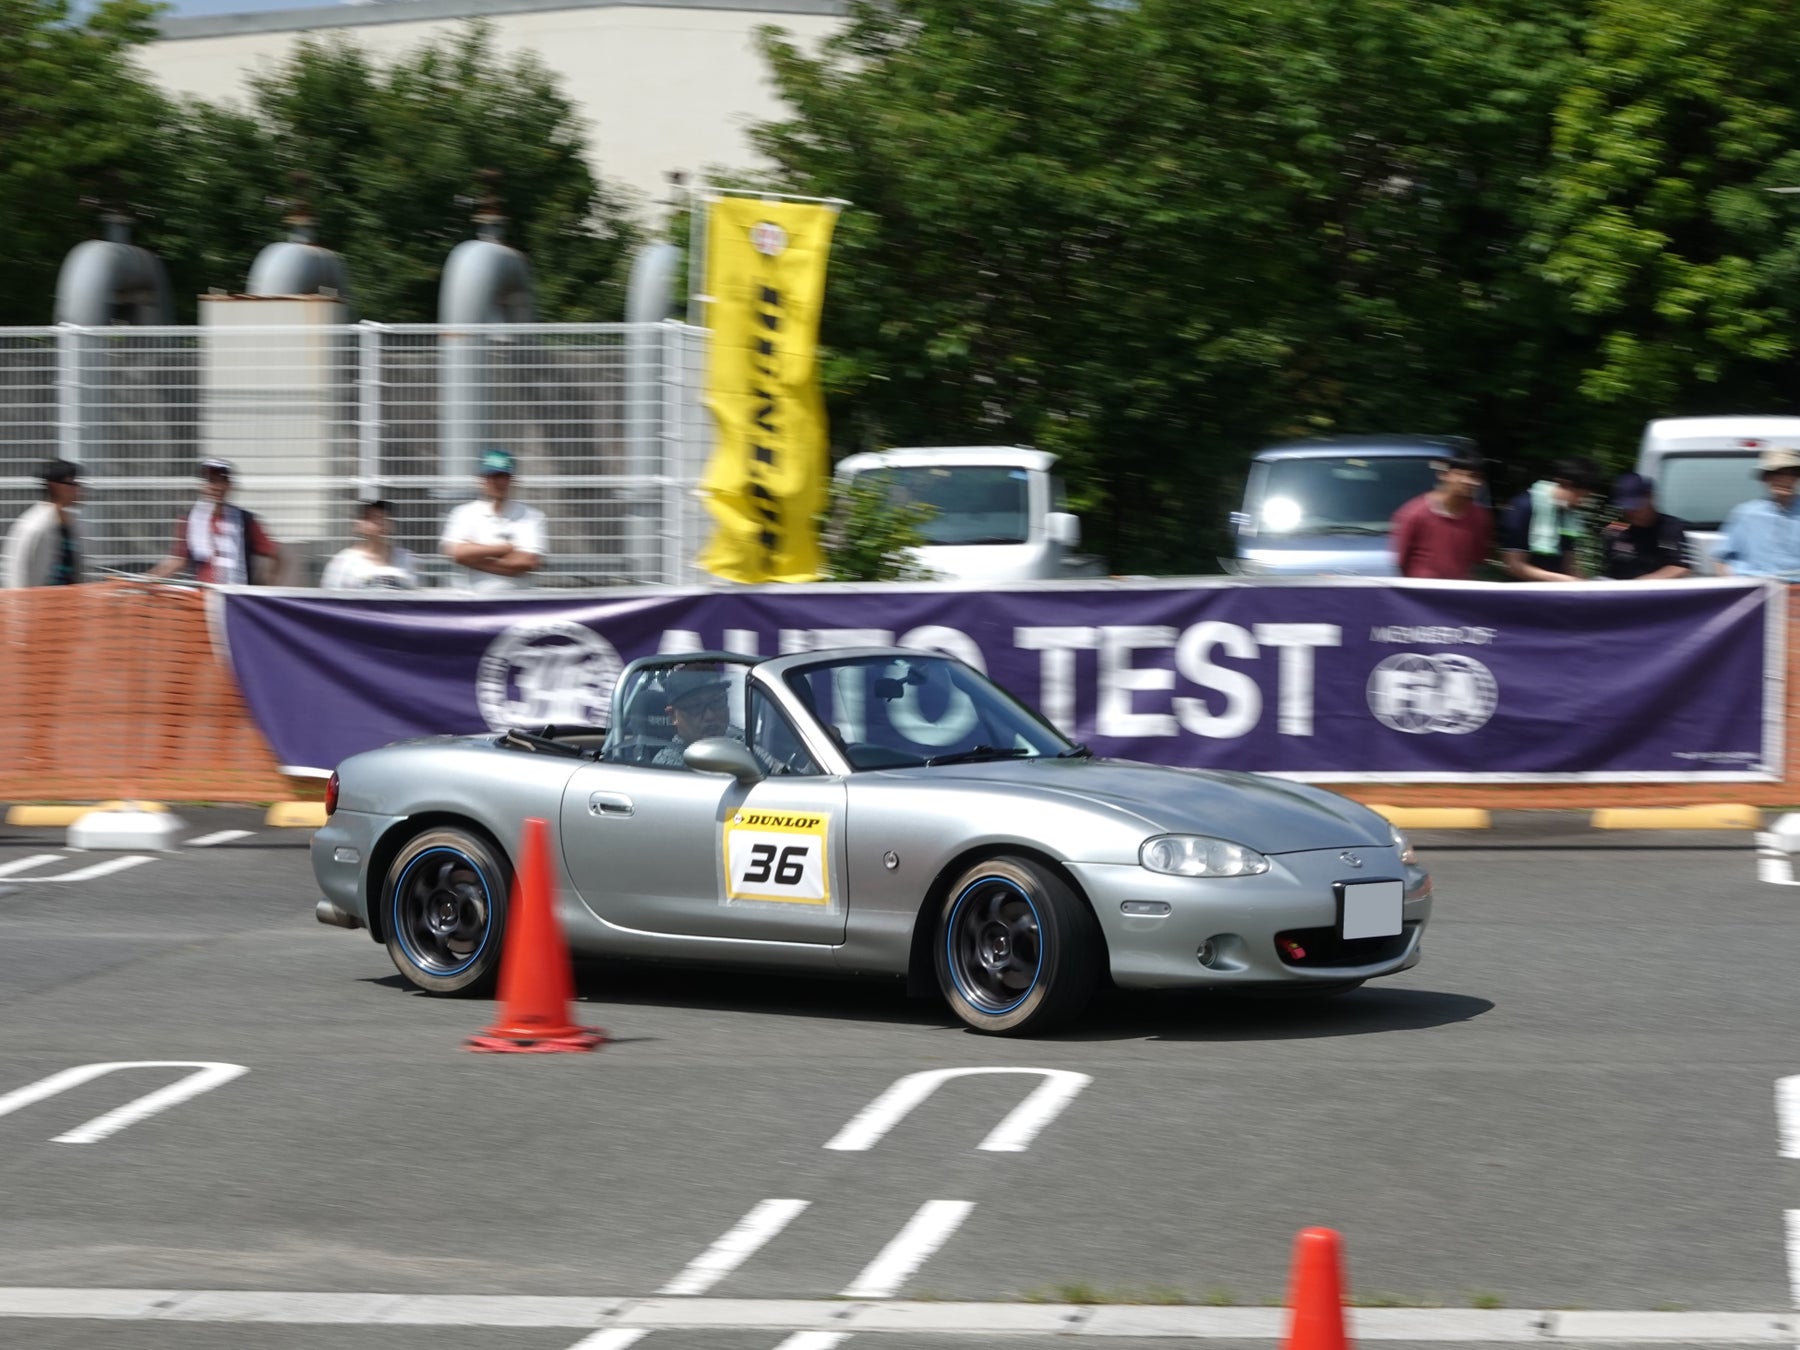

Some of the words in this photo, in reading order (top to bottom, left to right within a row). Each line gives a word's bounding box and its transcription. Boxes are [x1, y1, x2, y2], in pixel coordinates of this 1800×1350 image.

[1013, 621, 1342, 739] TEST
[747, 815, 820, 828] DUNLOP
[743, 844, 809, 885] 36
